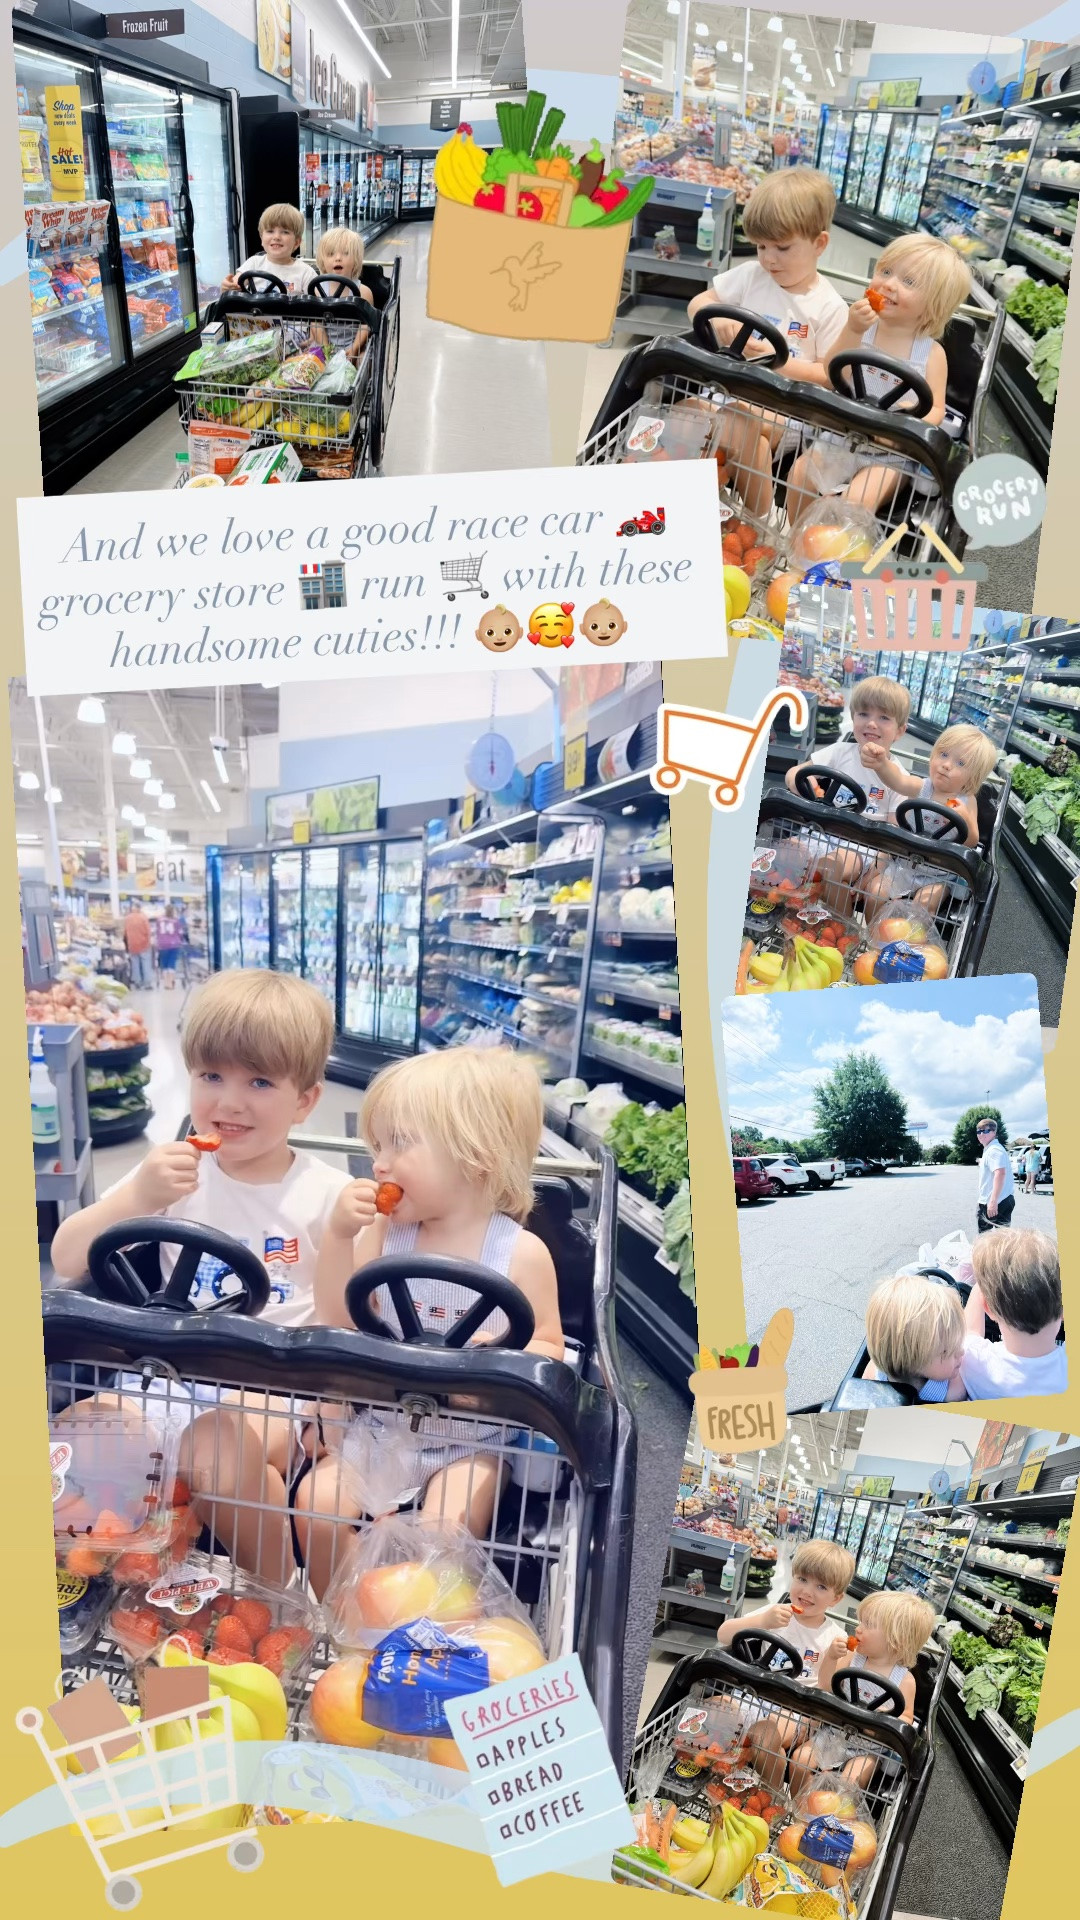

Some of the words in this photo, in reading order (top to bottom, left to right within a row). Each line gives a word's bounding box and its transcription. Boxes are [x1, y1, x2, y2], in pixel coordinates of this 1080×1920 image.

[122, 19, 148, 34] Frozen
[149, 18, 169, 32] Fruit
[309, 28, 328, 107] Ice
[330, 52, 357, 124] Cream
[53, 100, 75, 113] Shop
[57, 146, 74, 157] Hot
[51, 154, 84, 165] SALE!
[42, 208, 65, 220] Dream
[42, 217, 62, 229] Whip
